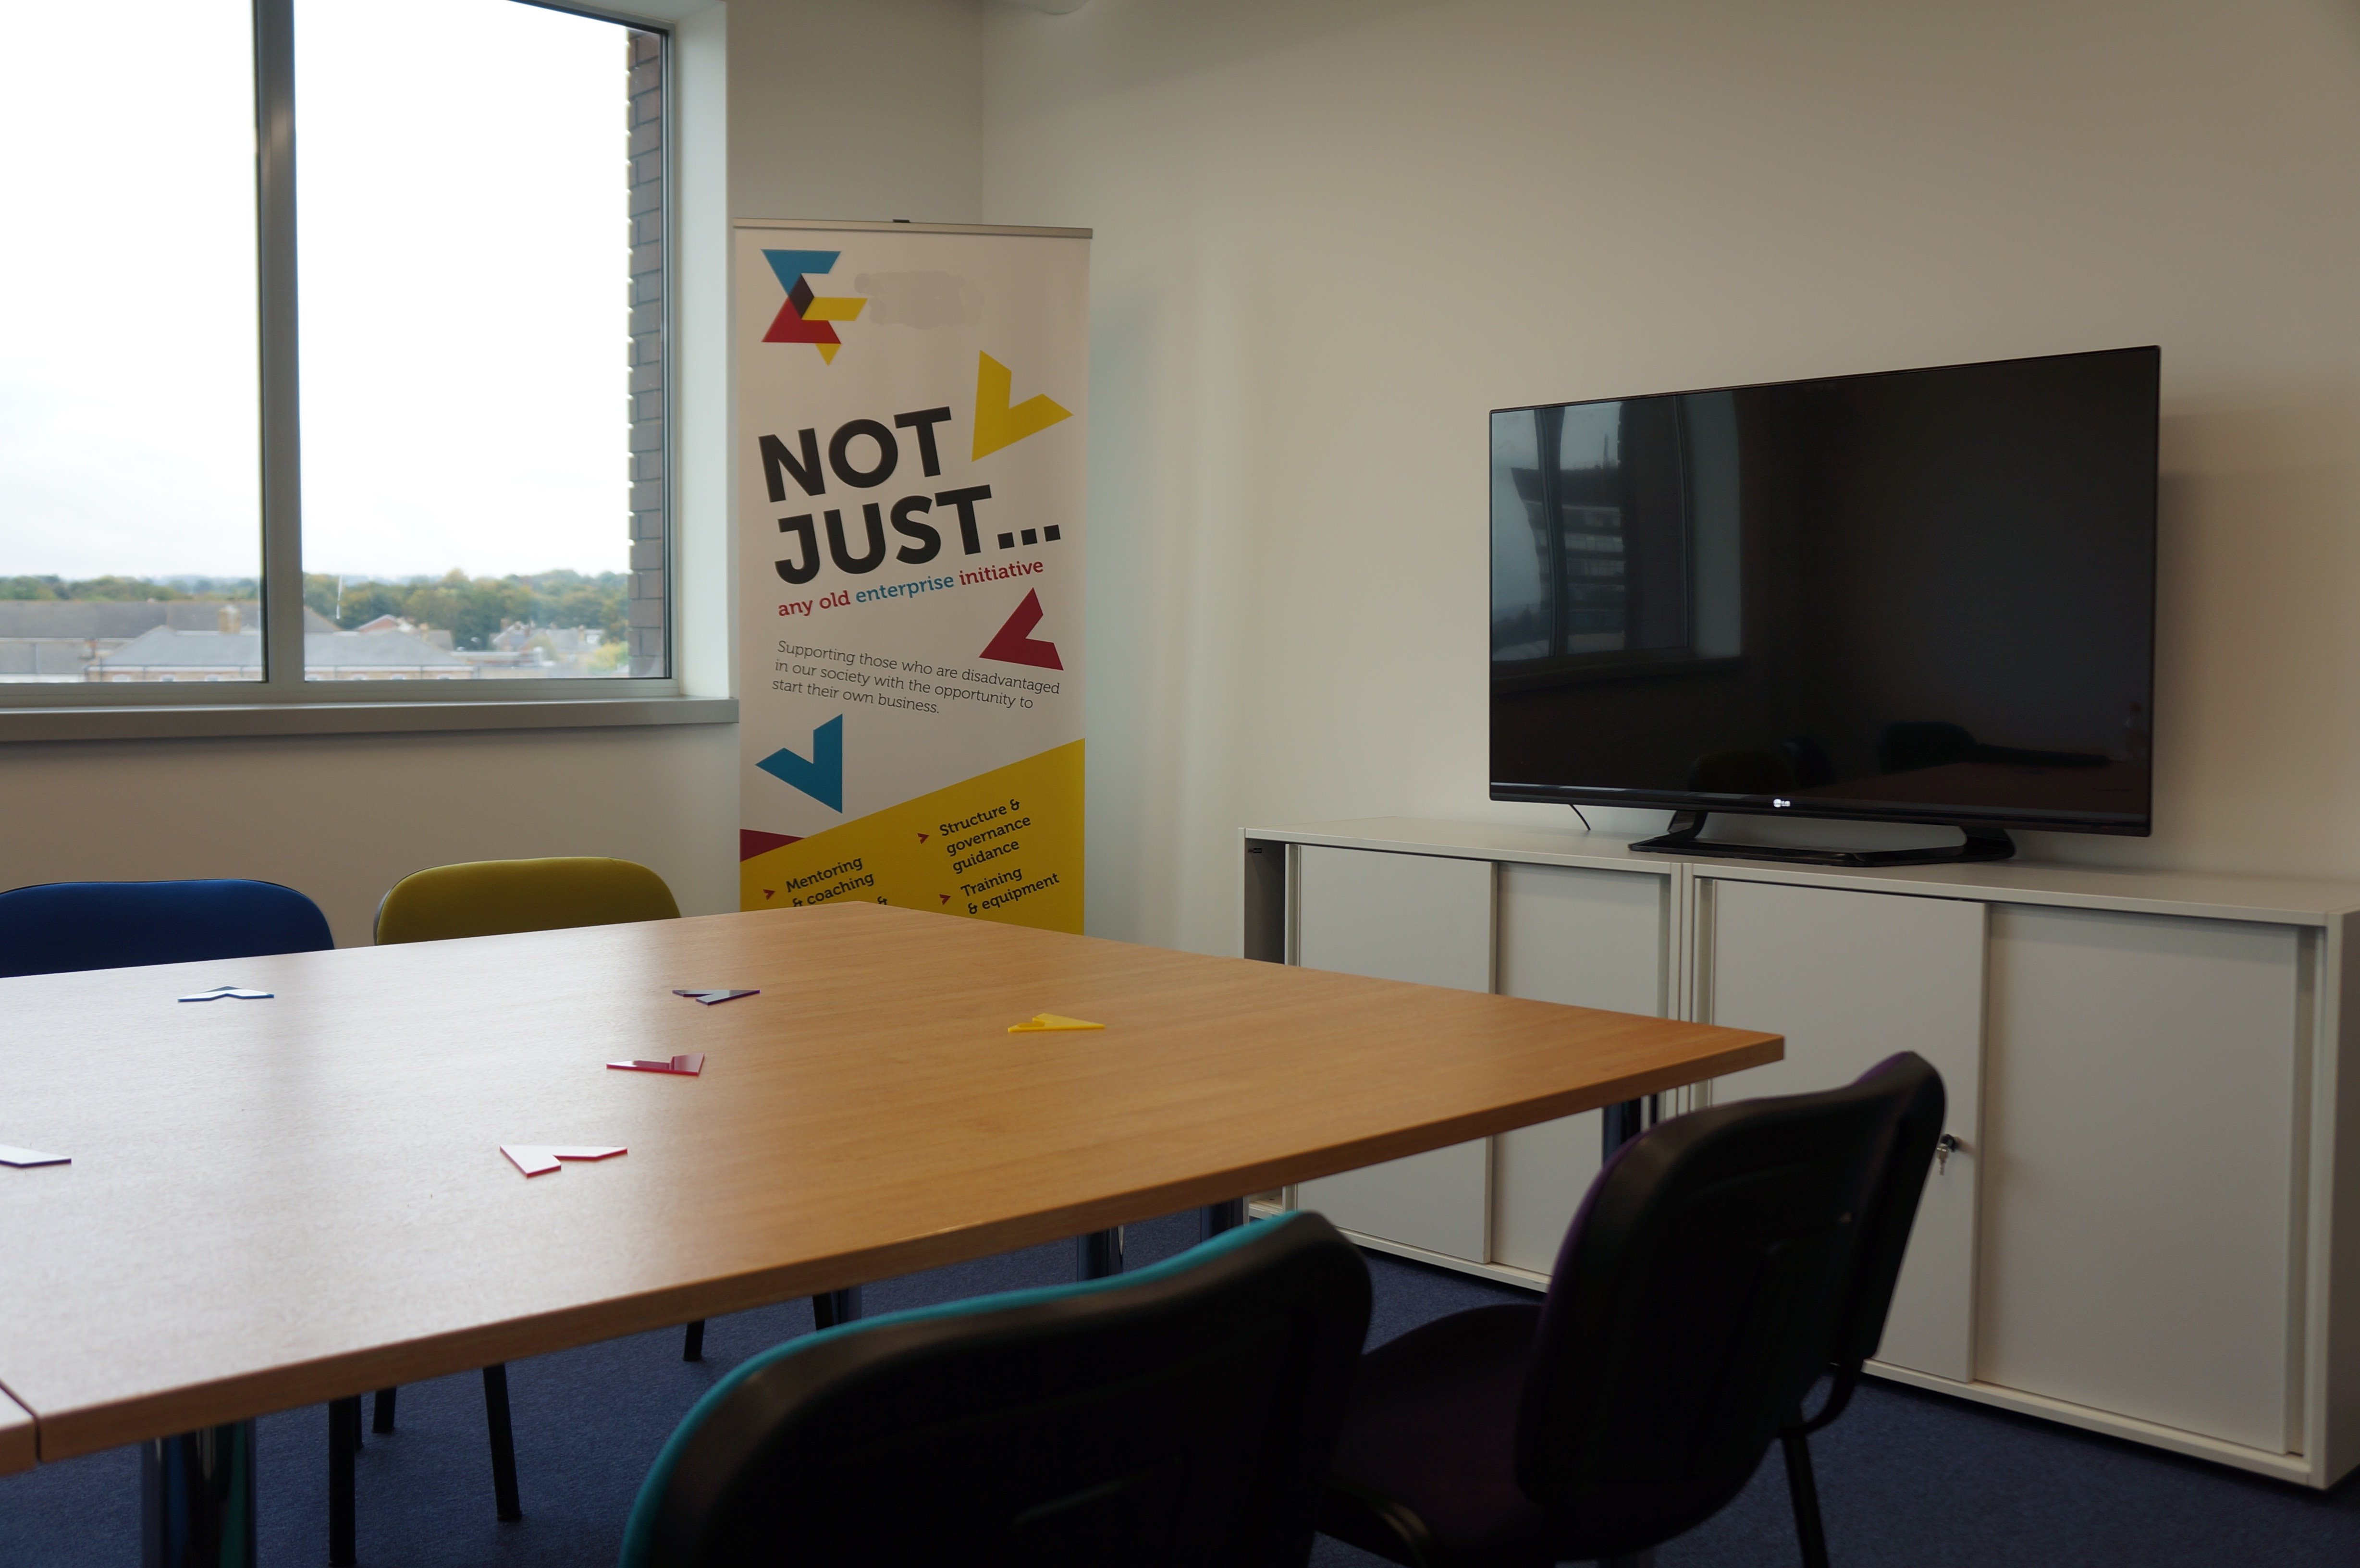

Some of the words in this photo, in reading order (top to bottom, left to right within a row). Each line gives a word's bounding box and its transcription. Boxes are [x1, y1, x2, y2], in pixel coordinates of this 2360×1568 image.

[758, 406, 951, 503] NOT
[774, 484, 1061, 584] JUST...
[778, 600, 812, 616] any
[819, 590, 850, 609] old
[856, 576, 954, 602] enterprise
[959, 561, 1044, 585] initiative
[775, 659, 787, 672] in
[793, 664, 817, 676] our
[820, 669, 870, 686] society
[874, 675, 904, 689] with
[909, 679, 930, 693] the
[935, 685, 1016, 709] opportunity
[1020, 697, 1033, 709] to
[777, 640, 855, 665] Supporting
[860, 653, 897, 669] those
[901, 661, 932, 674] who
[936, 667, 958, 678] are
[962, 669, 1060, 694] disadvantaged
[772, 679, 802, 693] start
[807, 683, 839, 698] their
[843, 691, 873, 704] own
[878, 693, 939, 713] business.
[939, 806, 1008, 836] Structure
[1010, 798, 1020, 811] &
[946, 817, 1031, 857] governance
[786, 858, 862, 893] Mentoring
[953, 841, 1020, 874] guidance
[792, 897, 802, 907] &
[807, 873, 874, 905] coaching
[960, 868, 1022, 897] Training
[968, 902, 977, 914] &
[982, 872, 1059, 908] equipment
